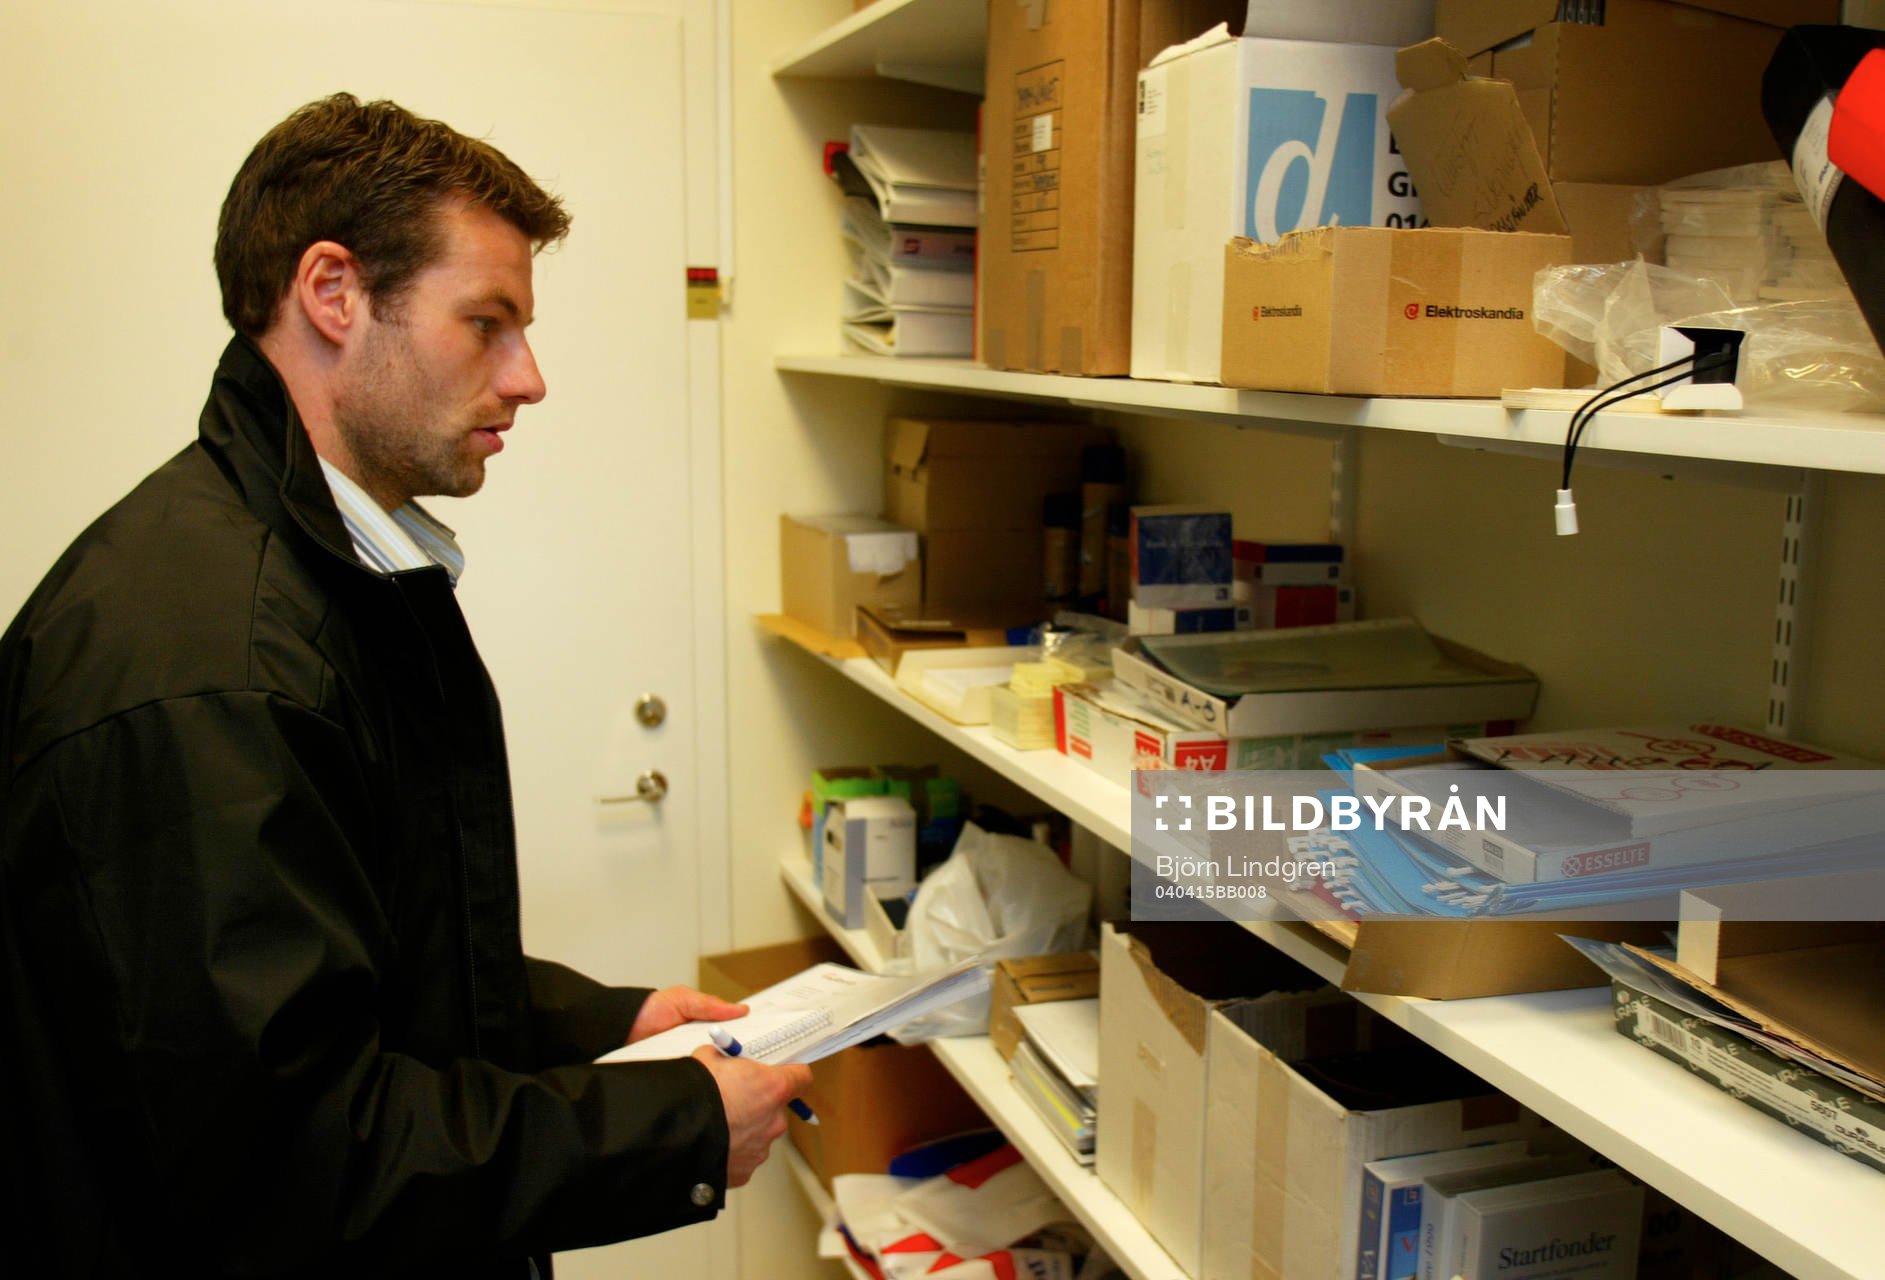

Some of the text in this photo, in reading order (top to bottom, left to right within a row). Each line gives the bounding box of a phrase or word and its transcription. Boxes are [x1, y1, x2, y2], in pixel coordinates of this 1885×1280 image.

[1426, 305, 1524, 320] Elektroskandia
[1584, 847, 1647, 871] ESSELTE
[1498, 1232, 1617, 1269] Startfonder
